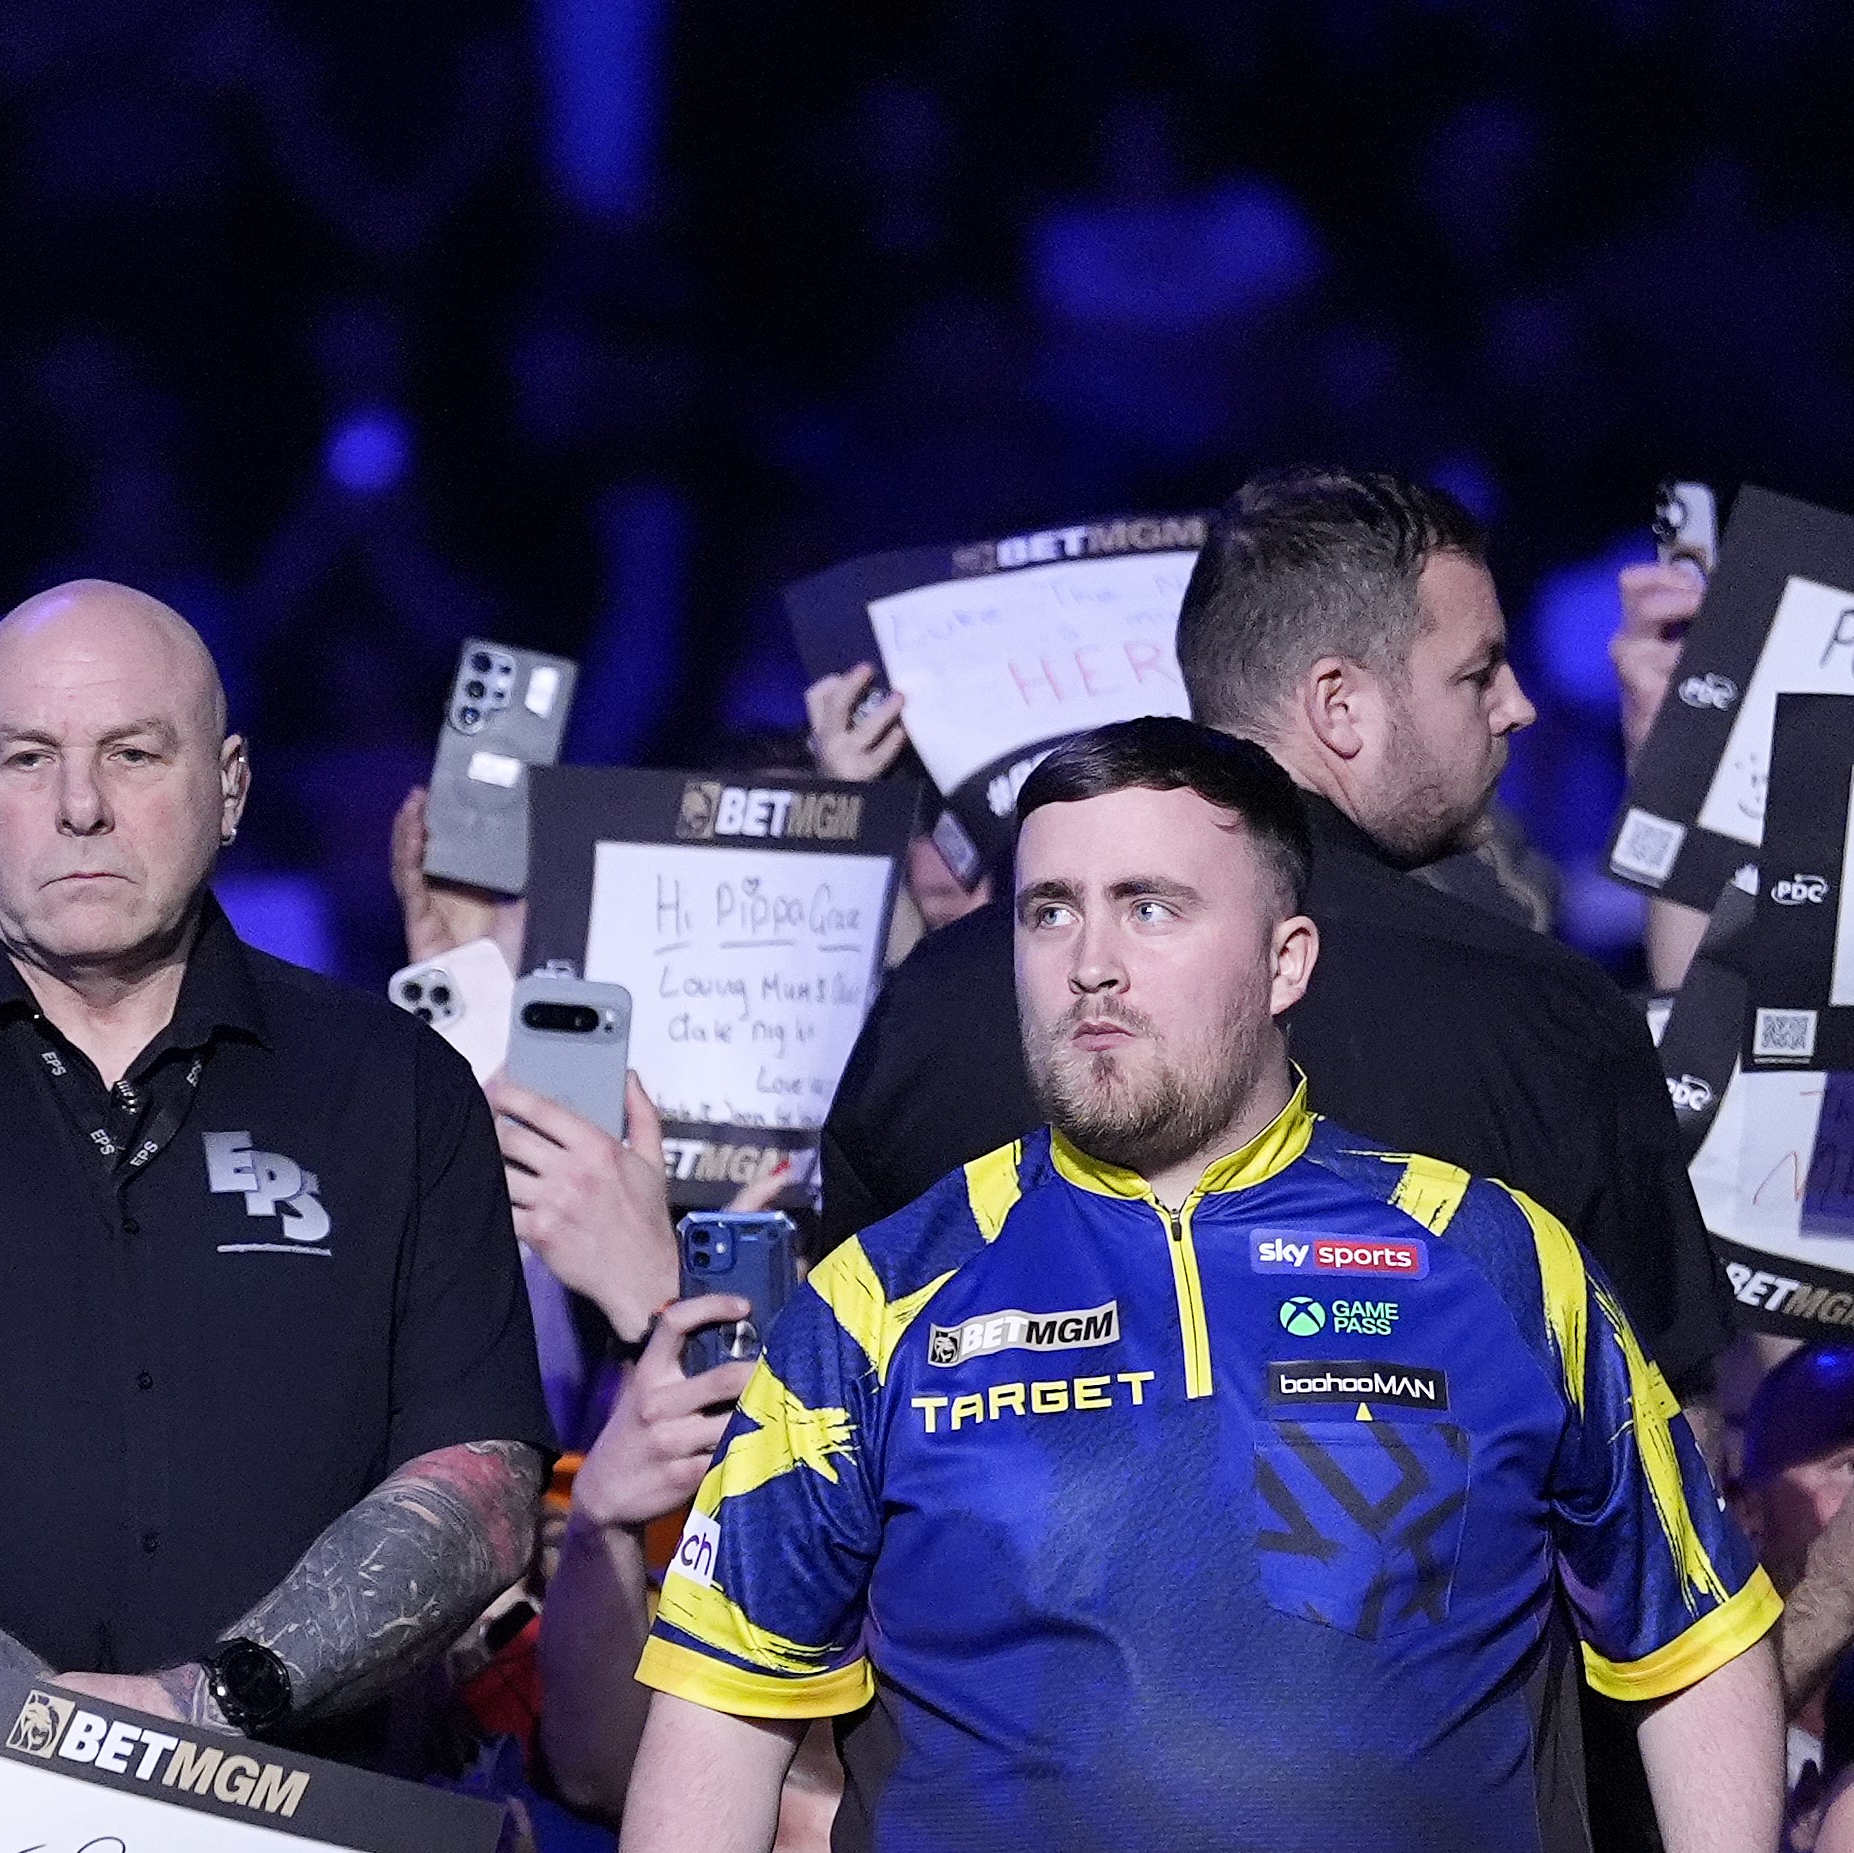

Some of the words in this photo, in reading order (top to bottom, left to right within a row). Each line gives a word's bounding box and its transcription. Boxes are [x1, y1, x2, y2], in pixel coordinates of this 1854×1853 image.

[1007, 640, 1180, 707] HER
[713, 788, 863, 841] BETMGM
[1770, 873, 1829, 906] PDC
[40, 1050, 68, 1078] EPS
[89, 1128, 116, 1157] EPS
[128, 1139, 160, 1168] EPS
[1258, 1238, 1310, 1268] sky
[1317, 1245, 1413, 1269] sports
[1331, 1299, 1400, 1321] GAME
[961, 1309, 1114, 1353] BETMGM
[1333, 1316, 1393, 1336] PASS
[1279, 1371, 1436, 1401] boohooMAN
[911, 1370, 1155, 1434] TARGET
[58, 1708, 311, 1818] BETMGM
